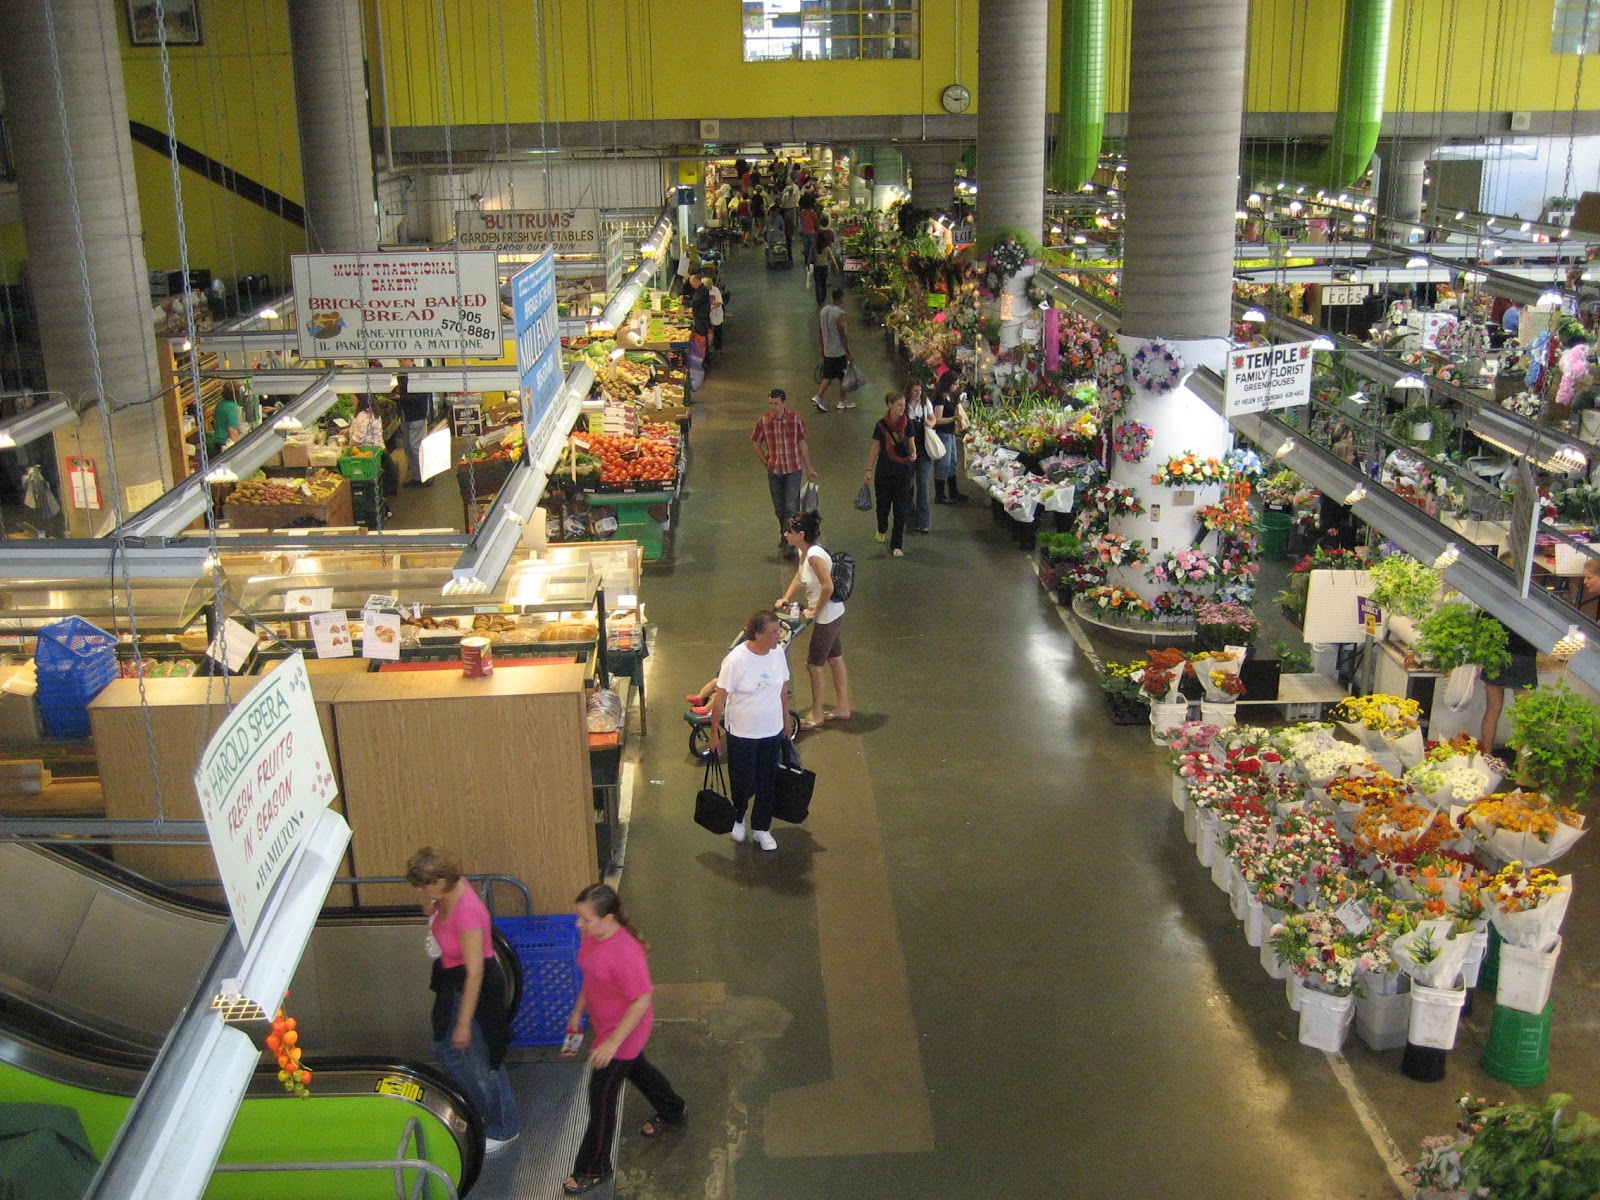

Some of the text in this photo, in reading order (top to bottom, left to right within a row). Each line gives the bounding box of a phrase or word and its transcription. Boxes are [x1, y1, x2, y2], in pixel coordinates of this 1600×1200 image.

[485, 213, 571, 229] BUTTRUMS
[460, 230, 594, 244] GARDEN FRESH VEGETABLES
[954, 230, 971, 241] EXIT
[526, 243, 546, 251] OUR
[333, 261, 455, 277] MULTI TRADITIONAL
[371, 278, 419, 292] BAKERY
[308, 294, 487, 310] BRICK-OVEN BAKED
[1329, 293, 1362, 304] EGGS
[362, 309, 435, 322] BREAD
[459, 310, 482, 324] 905
[356, 327, 443, 339] PANE-VITTORIA
[441, 319, 496, 341] 570-8881
[319, 339, 483, 351] IL PANE COTTO A MATTONE
[1246, 348, 1297, 369] TEMPLE
[1235, 364, 1305, 384] FAMILY FLORIST
[1243, 377, 1295, 392] GREENHOUSES
[208, 687, 290, 800] HAROLD SPERA
[227, 730, 294, 842] FRESH FRUITS
[243, 771, 294, 864] IN SEASON
[258, 815, 302, 890] HAMILTON
